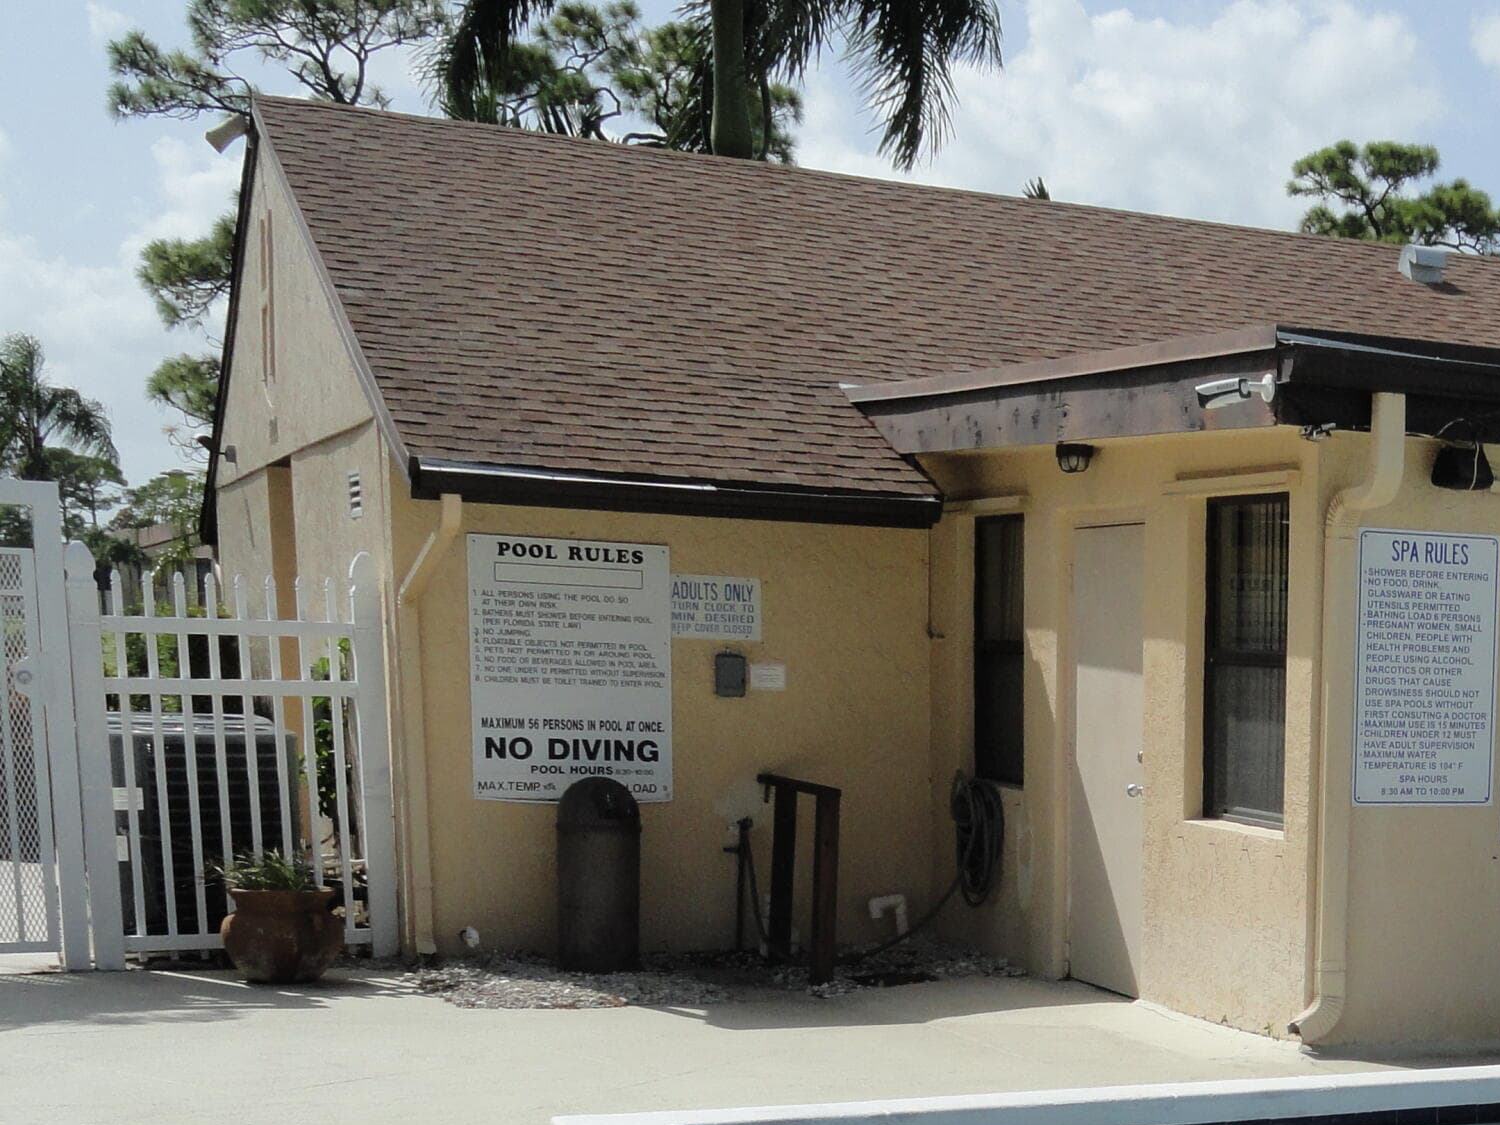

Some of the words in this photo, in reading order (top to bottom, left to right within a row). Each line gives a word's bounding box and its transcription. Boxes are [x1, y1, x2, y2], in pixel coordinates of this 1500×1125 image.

[497, 542, 557, 559] POOL
[568, 547, 644, 564] RULES
[1392, 540, 1419, 563] SPA
[1425, 542, 1469, 565] RULES
[1368, 568, 1407, 577] SHOWER
[1409, 570, 1444, 579] BEFORE
[1447, 572, 1489, 581] ENTERING
[1368, 578, 1381, 586] NO
[498, 591, 534, 599] PERSONS
[672, 582, 718, 601] ADULTS
[725, 584, 753, 602] ONLY
[1368, 589, 1422, 599] GLASSWARE
[1440, 593, 1471, 601] EATING
[672, 601, 699, 610] TURN
[704, 603, 736, 612] CLOCK
[743, 604, 754, 613] TO
[1368, 601, 1409, 609] UTENSILS
[1412, 602, 1460, 612] PERMITTED
[705, 613, 754, 623] DESIRED
[1367, 611, 1405, 619] BATHING
[1408, 612, 1432, 620] LOAD
[1441, 614, 1481, 622] PERSONS
[1367, 621, 1414, 629] PREGNANT
[1455, 624, 1482, 632] SMALL
[1416, 634, 1449, 642] PEOPLE
[1451, 635, 1473, 643] WITH
[1367, 643, 1400, 651] HEALTH
[1403, 644, 1450, 653] PROBLEMS
[1452, 646, 1470, 654] AND
[1367, 654, 1400, 663] PEOPLE
[1403, 655, 1429, 664] USING
[1366, 665, 1416, 674] NARCOTICS
[1419, 667, 1431, 675] OR
[1433, 668, 1463, 676] OTHER
[1366, 677, 1396, 685] DRUGS
[1399, 678, 1420, 686] THAT
[1423, 678, 1452, 686] CAUSE
[1365, 688, 1423, 697] DROWSINESS
[1425, 689, 1460, 698] SHOULD
[1462, 690, 1480, 698] NOT
[1365, 699, 1382, 707] USE
[1404, 700, 1433, 708] POOLS
[1435, 701, 1473, 709] WITHOUT
[1392, 711, 1442, 719] CONSUTING
[481, 718, 525, 729] MAXIMUM
[528, 718, 540, 729] 56
[543, 719, 584, 731] PERSONS
[587, 720, 596, 731] IN
[600, 721, 622, 732] POOL
[626, 722, 635, 732] AT
[638, 722, 665, 733] ONCE.
[1364, 720, 1405, 728] MAXIMUM
[1408, 721, 1425, 729] USE
[1427, 721, 1435, 729] IS
[1438, 721, 1447, 729] 15
[1450, 721, 1486, 729] MINUTES
[1364, 730, 1408, 738] CHILDREN
[1443, 731, 1451, 739] 12
[1454, 731, 1477, 739] MUST
[485, 737, 533, 760] NO
[549, 738, 659, 762] DIVING
[1364, 741, 1387, 749] HAVE
[531, 765, 565, 774] POOL
[570, 766, 614, 775] HOURS
